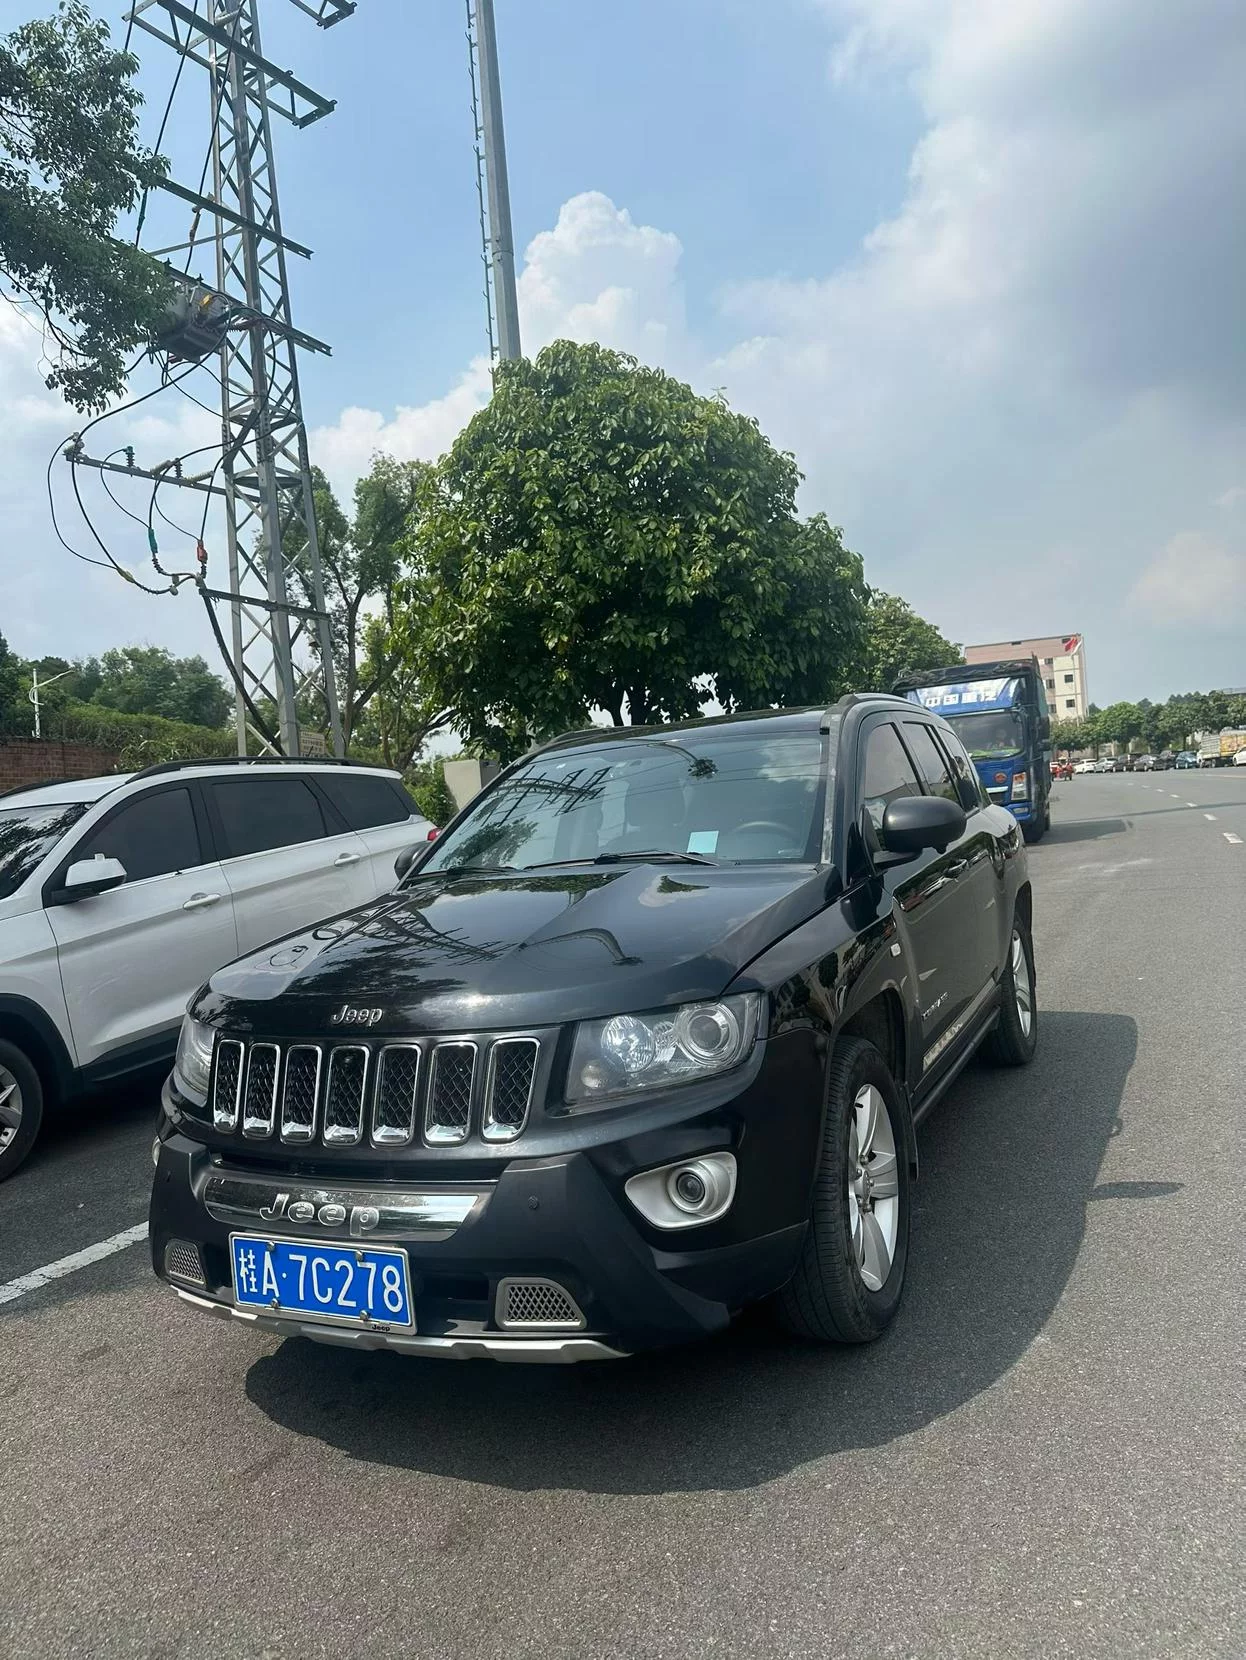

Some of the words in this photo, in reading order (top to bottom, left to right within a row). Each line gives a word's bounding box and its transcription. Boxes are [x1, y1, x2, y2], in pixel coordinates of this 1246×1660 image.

[331, 1004, 383, 1027] Jeep
[259, 1193, 380, 1236] Jeep
[371, 1324, 391, 1333] Jeep
